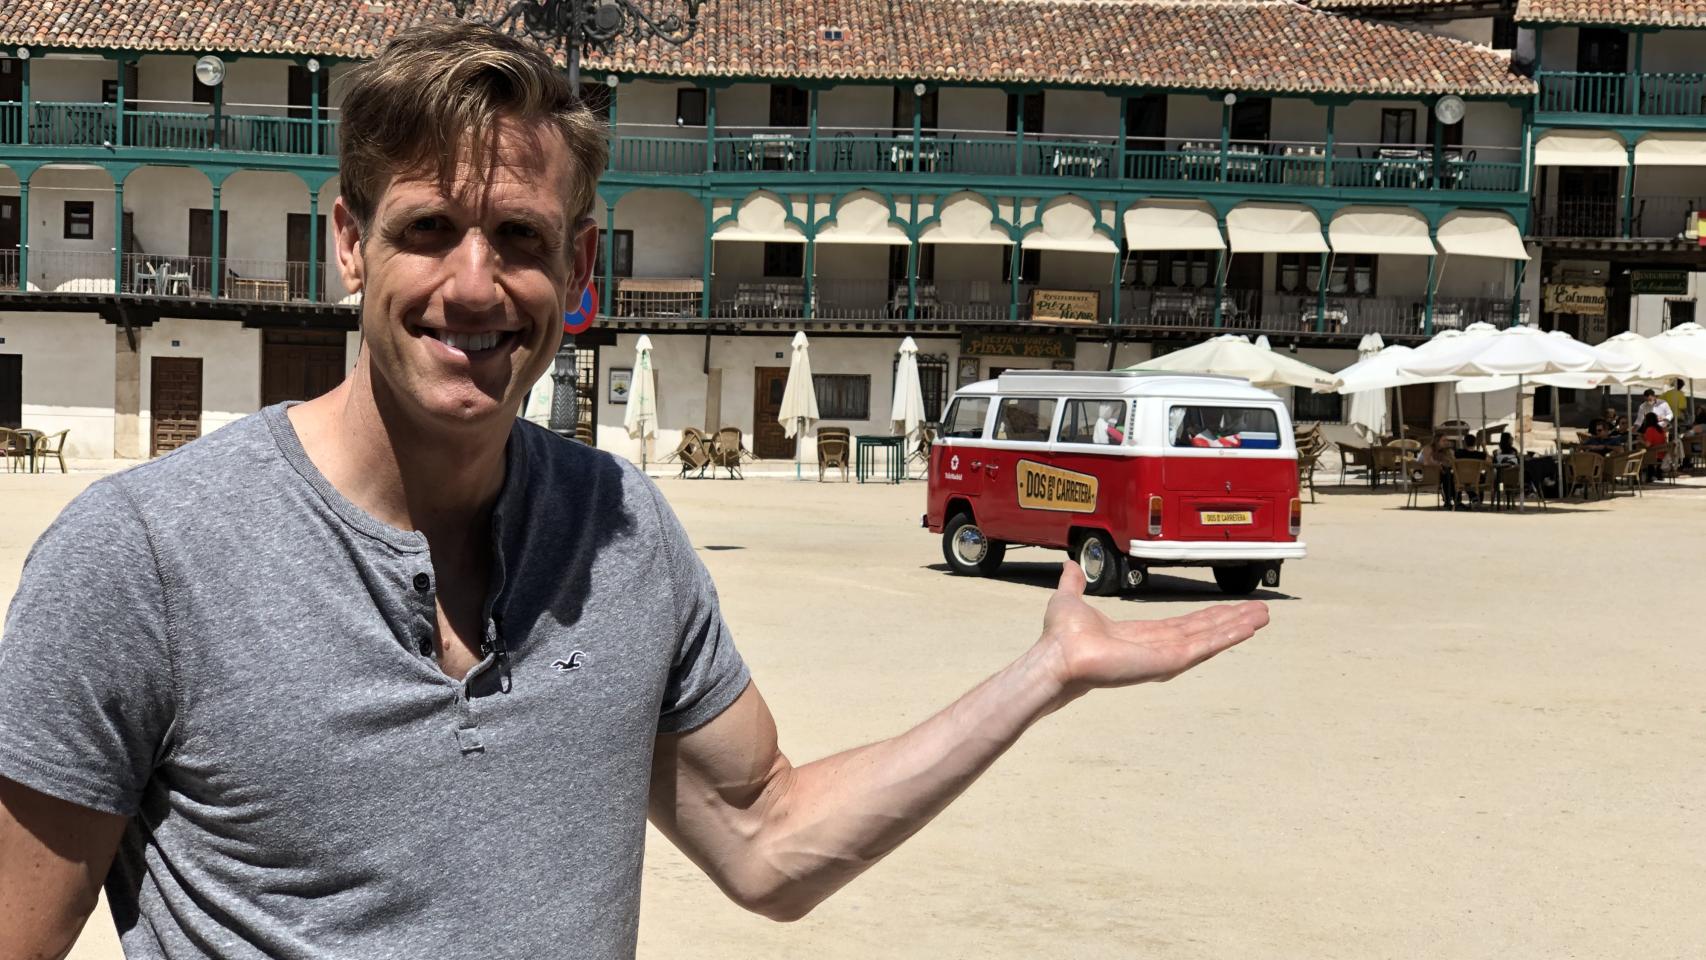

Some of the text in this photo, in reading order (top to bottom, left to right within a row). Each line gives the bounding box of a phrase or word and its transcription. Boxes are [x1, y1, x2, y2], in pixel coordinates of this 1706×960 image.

[1555, 290, 1605, 304] Columna
[1026, 470, 1047, 499] DOS
[1056, 477, 1092, 504] CARRETERA
